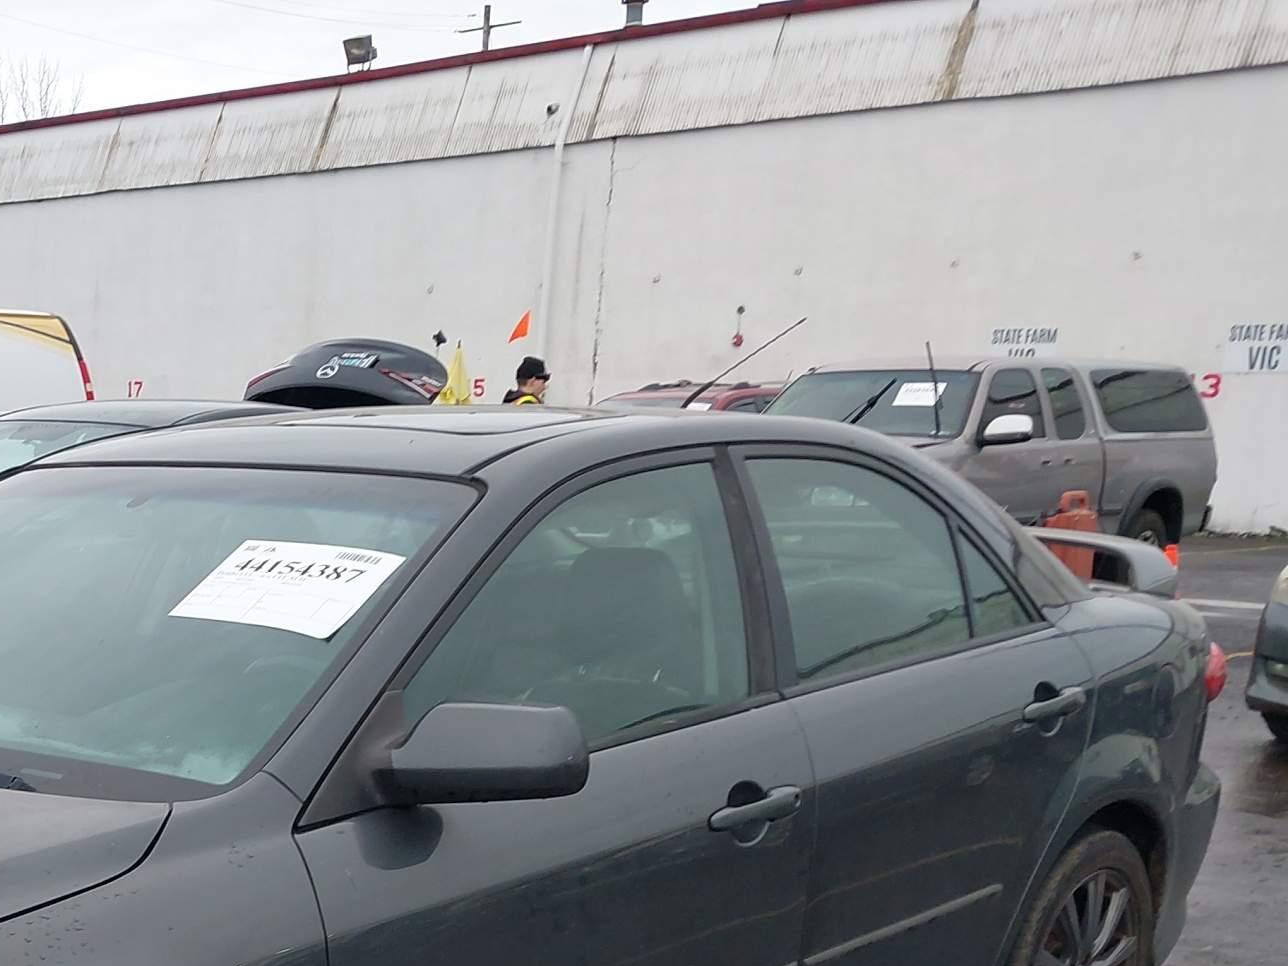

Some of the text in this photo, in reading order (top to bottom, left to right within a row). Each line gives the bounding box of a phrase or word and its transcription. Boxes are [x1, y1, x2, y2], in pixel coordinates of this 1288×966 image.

[991, 327, 1058, 344] STATE FARM
[1229, 324, 1288, 342] STATE FA
[1249, 345, 1281, 370] VIC
[128, 380, 143, 398] 17
[235, 558, 367, 584] 44154387
